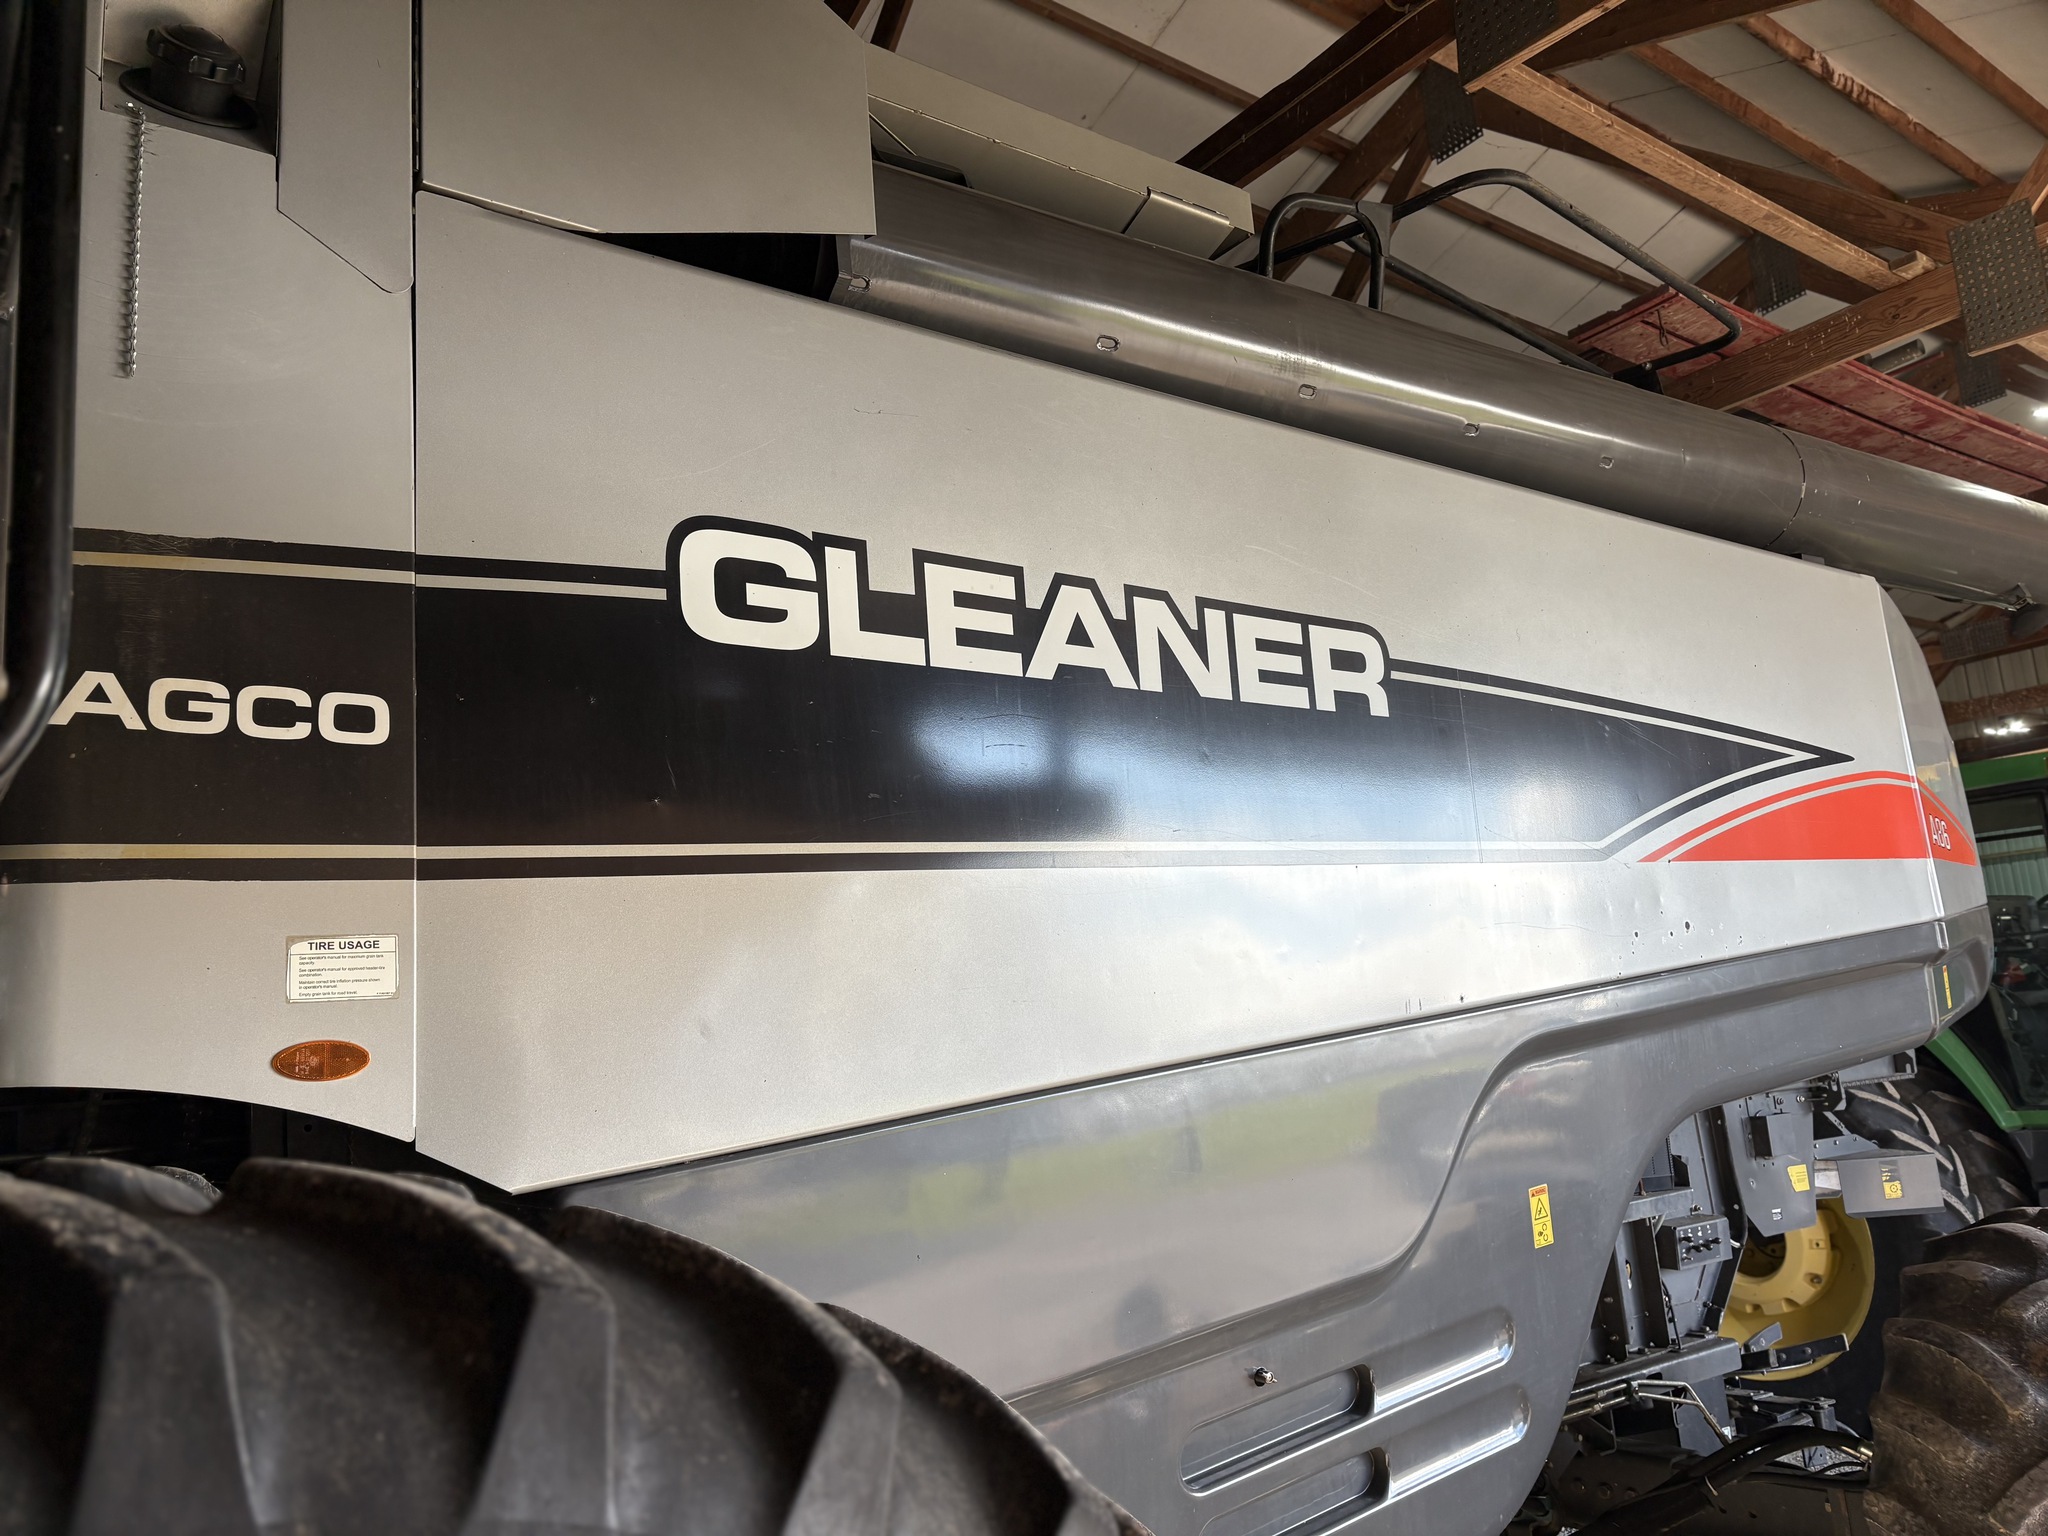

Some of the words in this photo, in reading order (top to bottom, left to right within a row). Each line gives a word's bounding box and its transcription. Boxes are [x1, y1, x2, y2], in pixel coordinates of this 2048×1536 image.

[678, 527, 1390, 718] GLEANER
[46, 670, 390, 746] AGCO
[308, 941, 335, 950] TIRE
[338, 940, 380, 950] USAGE
